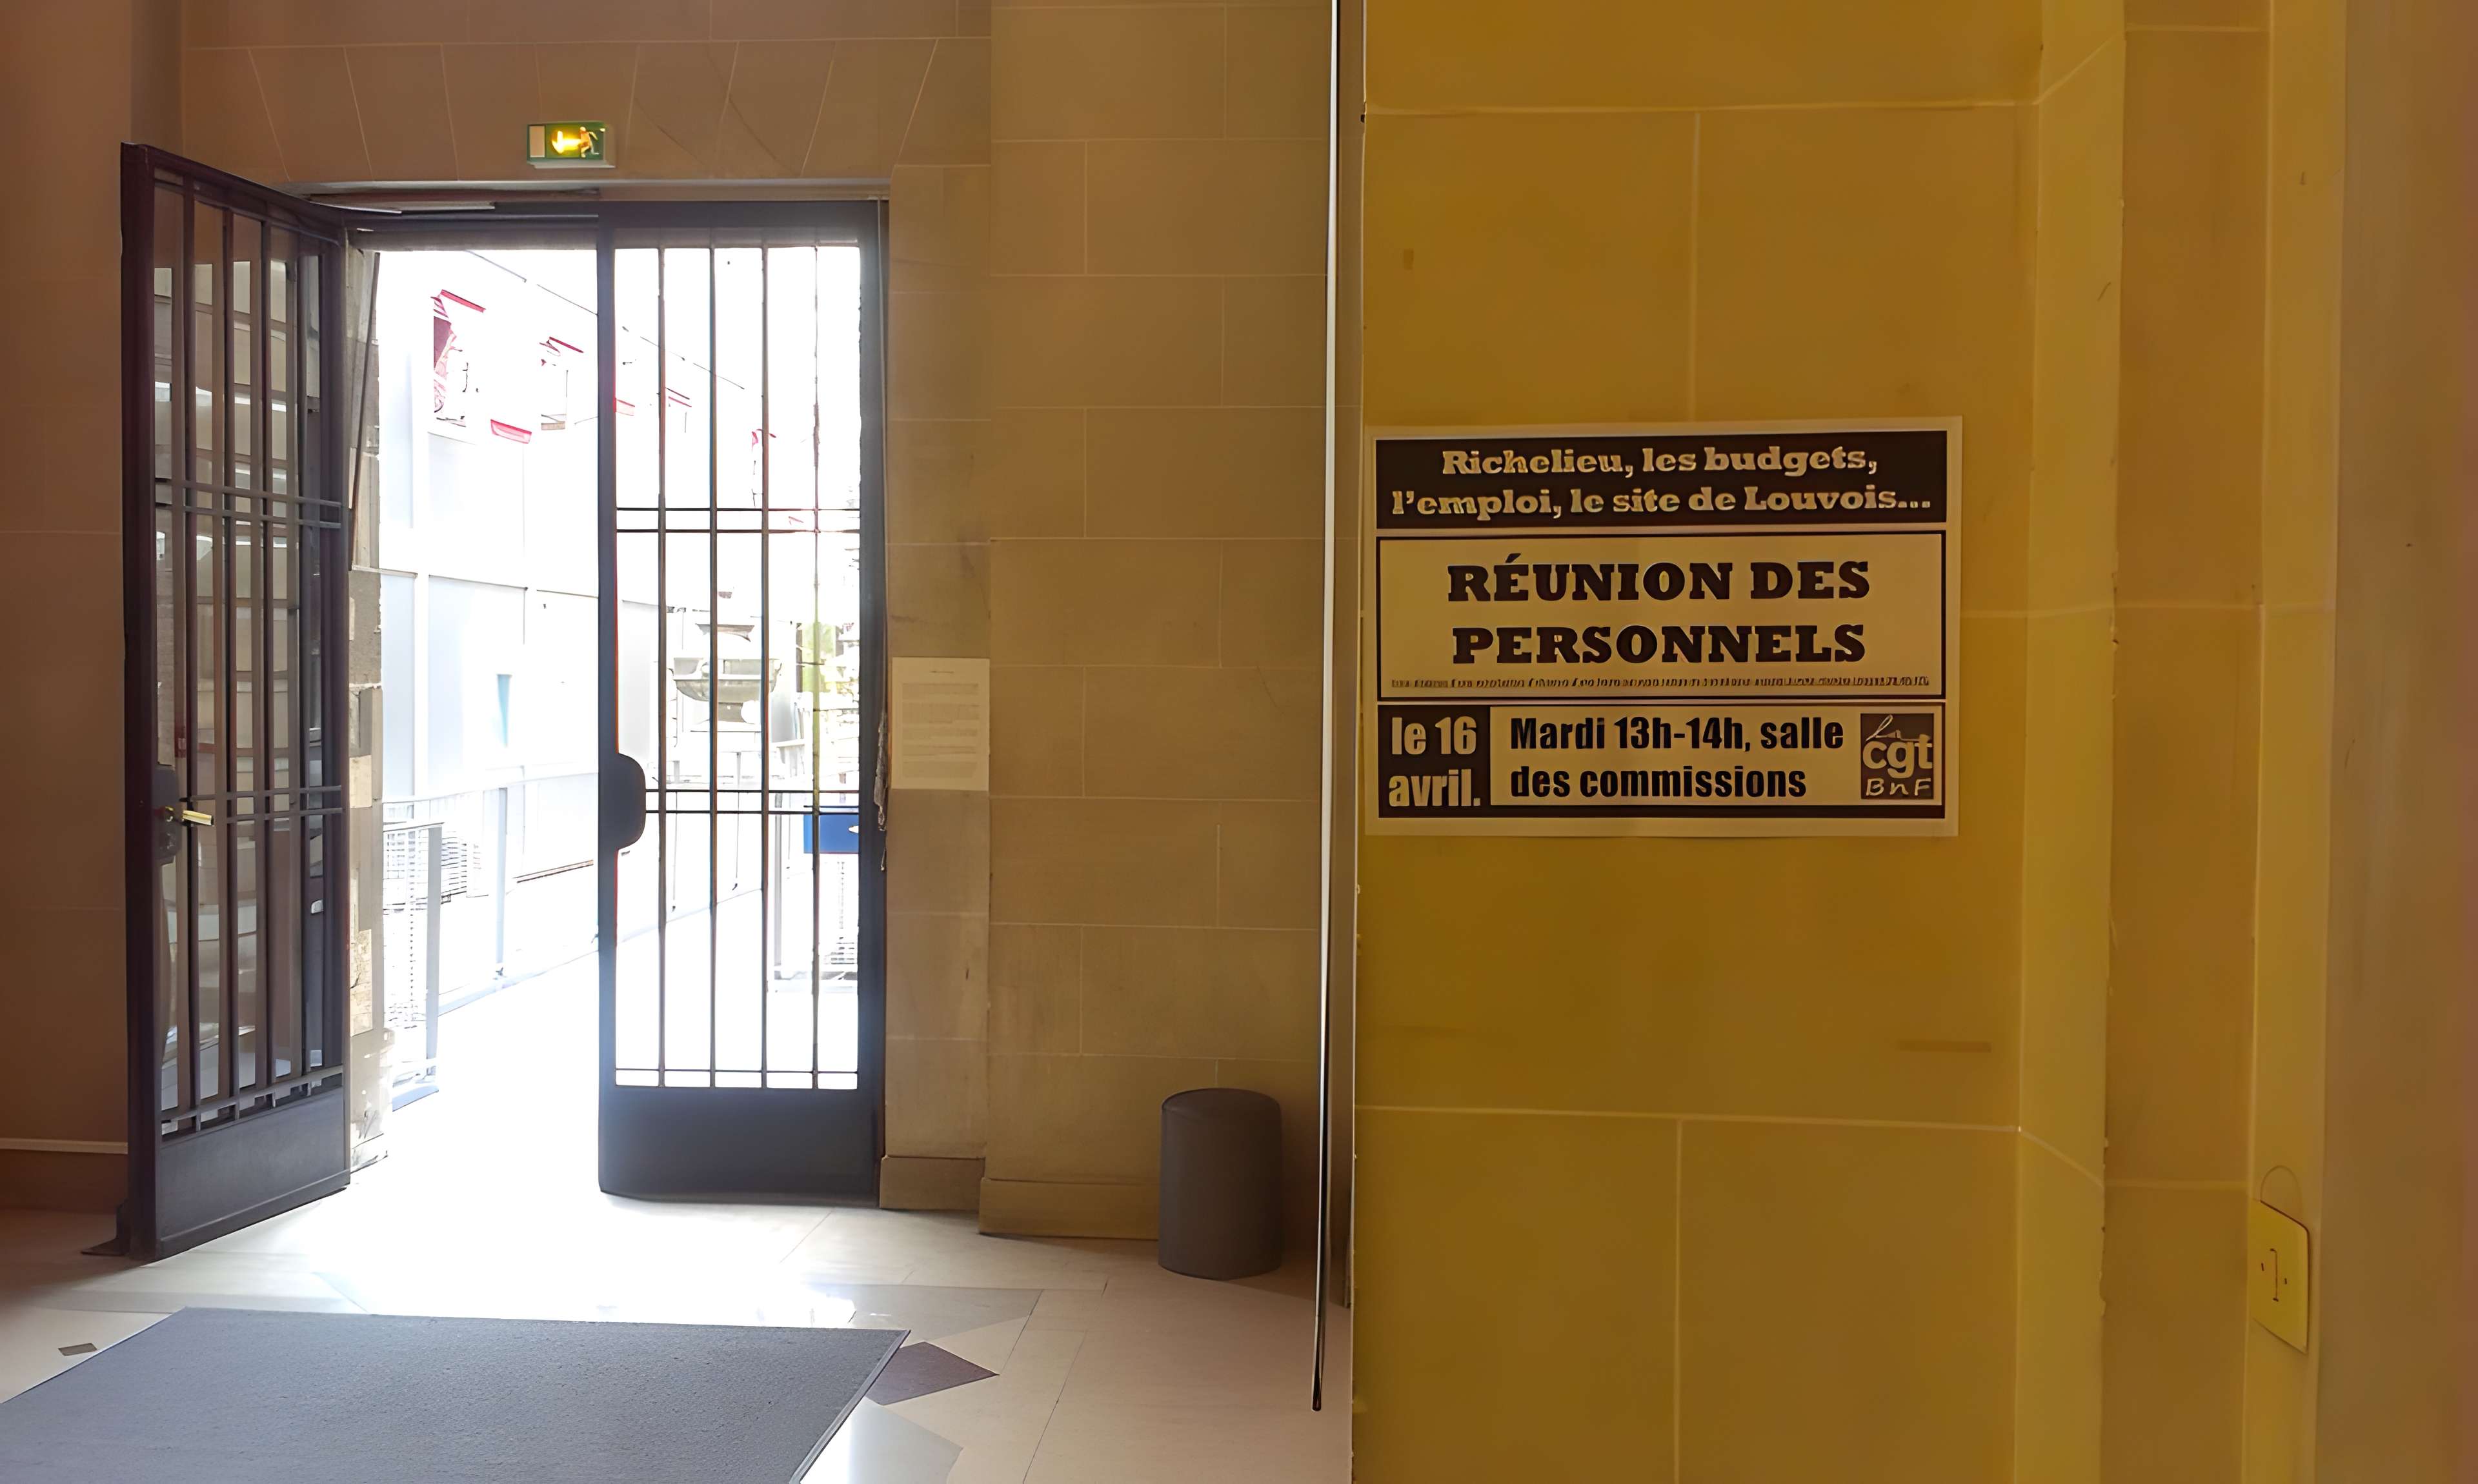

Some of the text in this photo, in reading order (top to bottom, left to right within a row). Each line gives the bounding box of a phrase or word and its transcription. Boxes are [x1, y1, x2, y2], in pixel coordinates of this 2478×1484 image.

[1443, 446, 1877, 478] Richelieu, les budgets,
[1571, 488, 1604, 513] le
[1613, 488, 1680, 512] site
[1688, 486, 1736, 512] de
[1744, 485, 1931, 511] Louvois...
[1447, 553, 1869, 601] RÉUNION DES
[1453, 624, 1865, 663] PERSONNELS
[1391, 716, 1476, 755] le 16
[1511, 716, 1844, 752] Mardi 13h-14h, salle
[1862, 734, 1933, 779] cgt
[1389, 768, 1480, 807] avril.
[1511, 765, 1807, 797] des commissions
[1866, 777, 1931, 796] BnF
